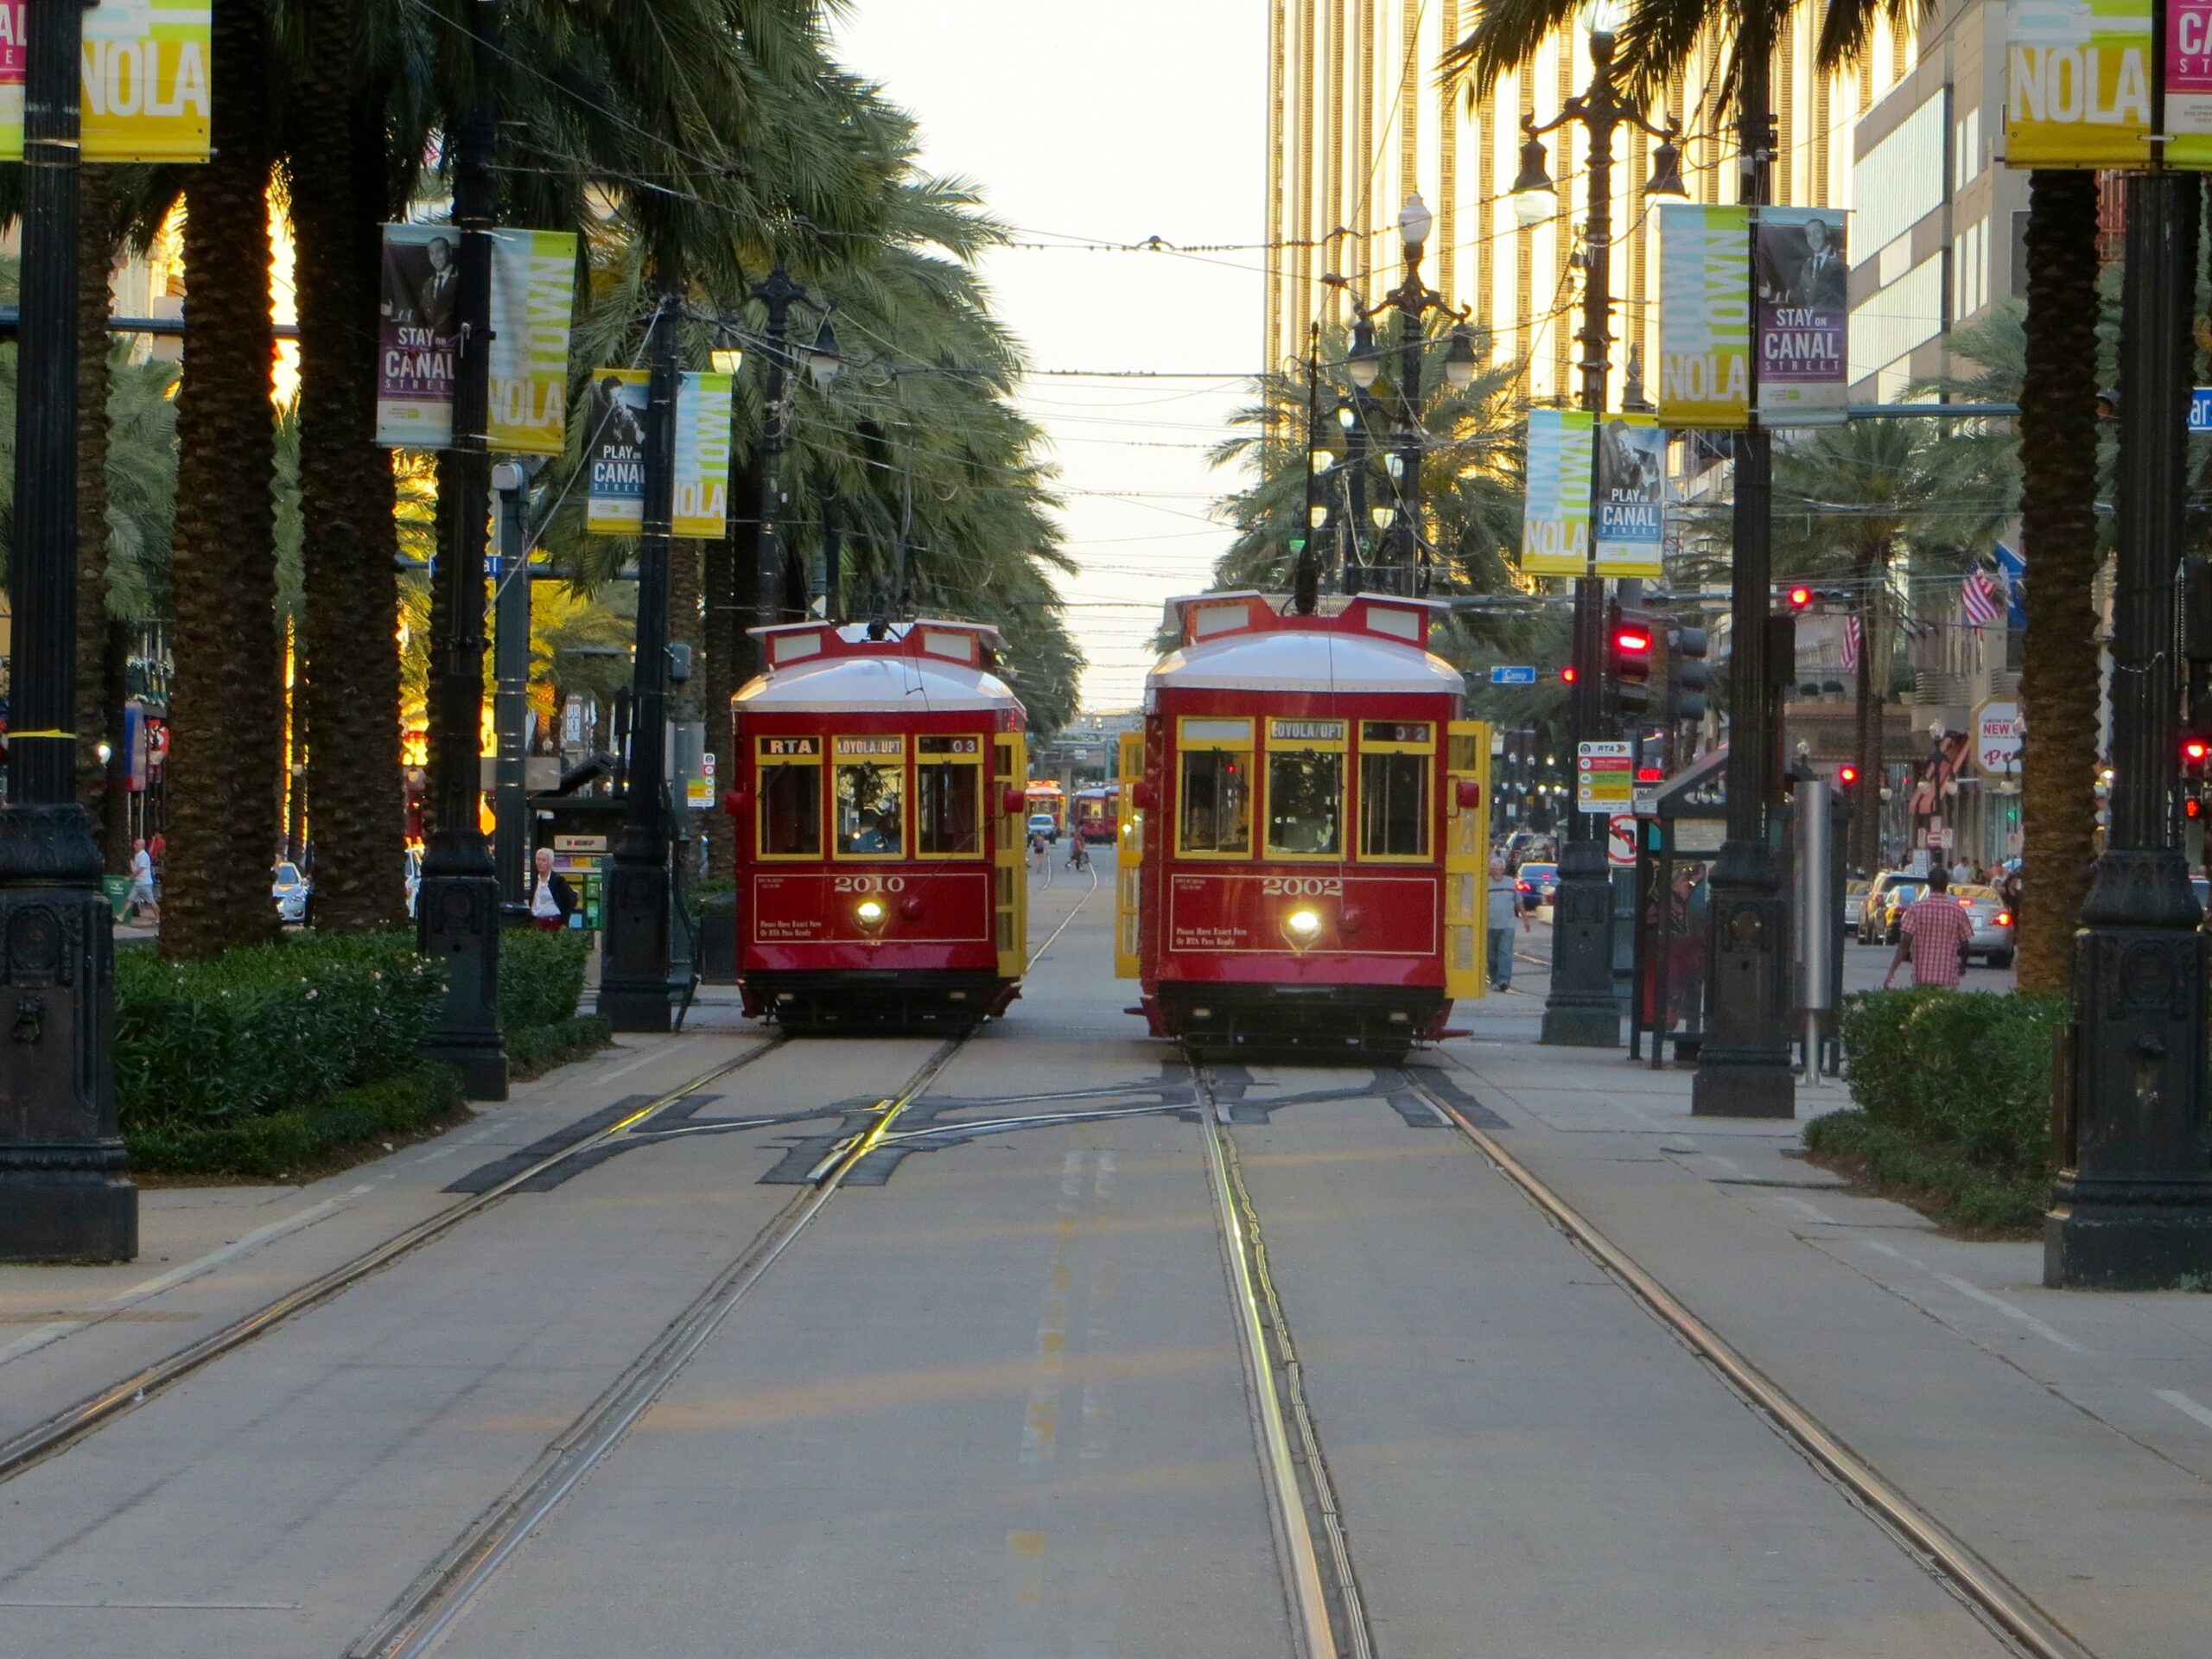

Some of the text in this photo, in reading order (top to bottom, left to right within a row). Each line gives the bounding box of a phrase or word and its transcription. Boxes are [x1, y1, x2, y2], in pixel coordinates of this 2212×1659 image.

[81, 41, 210, 117] NOLA
[2010, 48, 2152, 124] NOLA
[1702, 230, 1750, 353] TOWN
[520, 256, 575, 378] TOWN
[1776, 308, 1827, 327] STAY ON
[397, 327, 434, 346] STAY
[1764, 333, 1839, 360] CANAL
[1764, 360, 1839, 372] STREET
[385, 379, 447, 391] STREE
[1662, 354, 1748, 402] NOLA
[488, 379, 566, 428] NOLA
[691, 391, 732, 482] TOWN
[604, 445, 633, 460] PLAY
[1556, 429, 1593, 521] TOWN
[1611, 488, 1640, 502] PLAY
[1603, 506, 1657, 526] CANAL
[1524, 521, 1586, 556] NOLA
[1602, 526, 1657, 535] STREET
[1983, 724, 2009, 735] NEW
[770, 740, 812, 753] RTA
[834, 876, 906, 893] 2010
[1262, 877, 1344, 896] 2002
